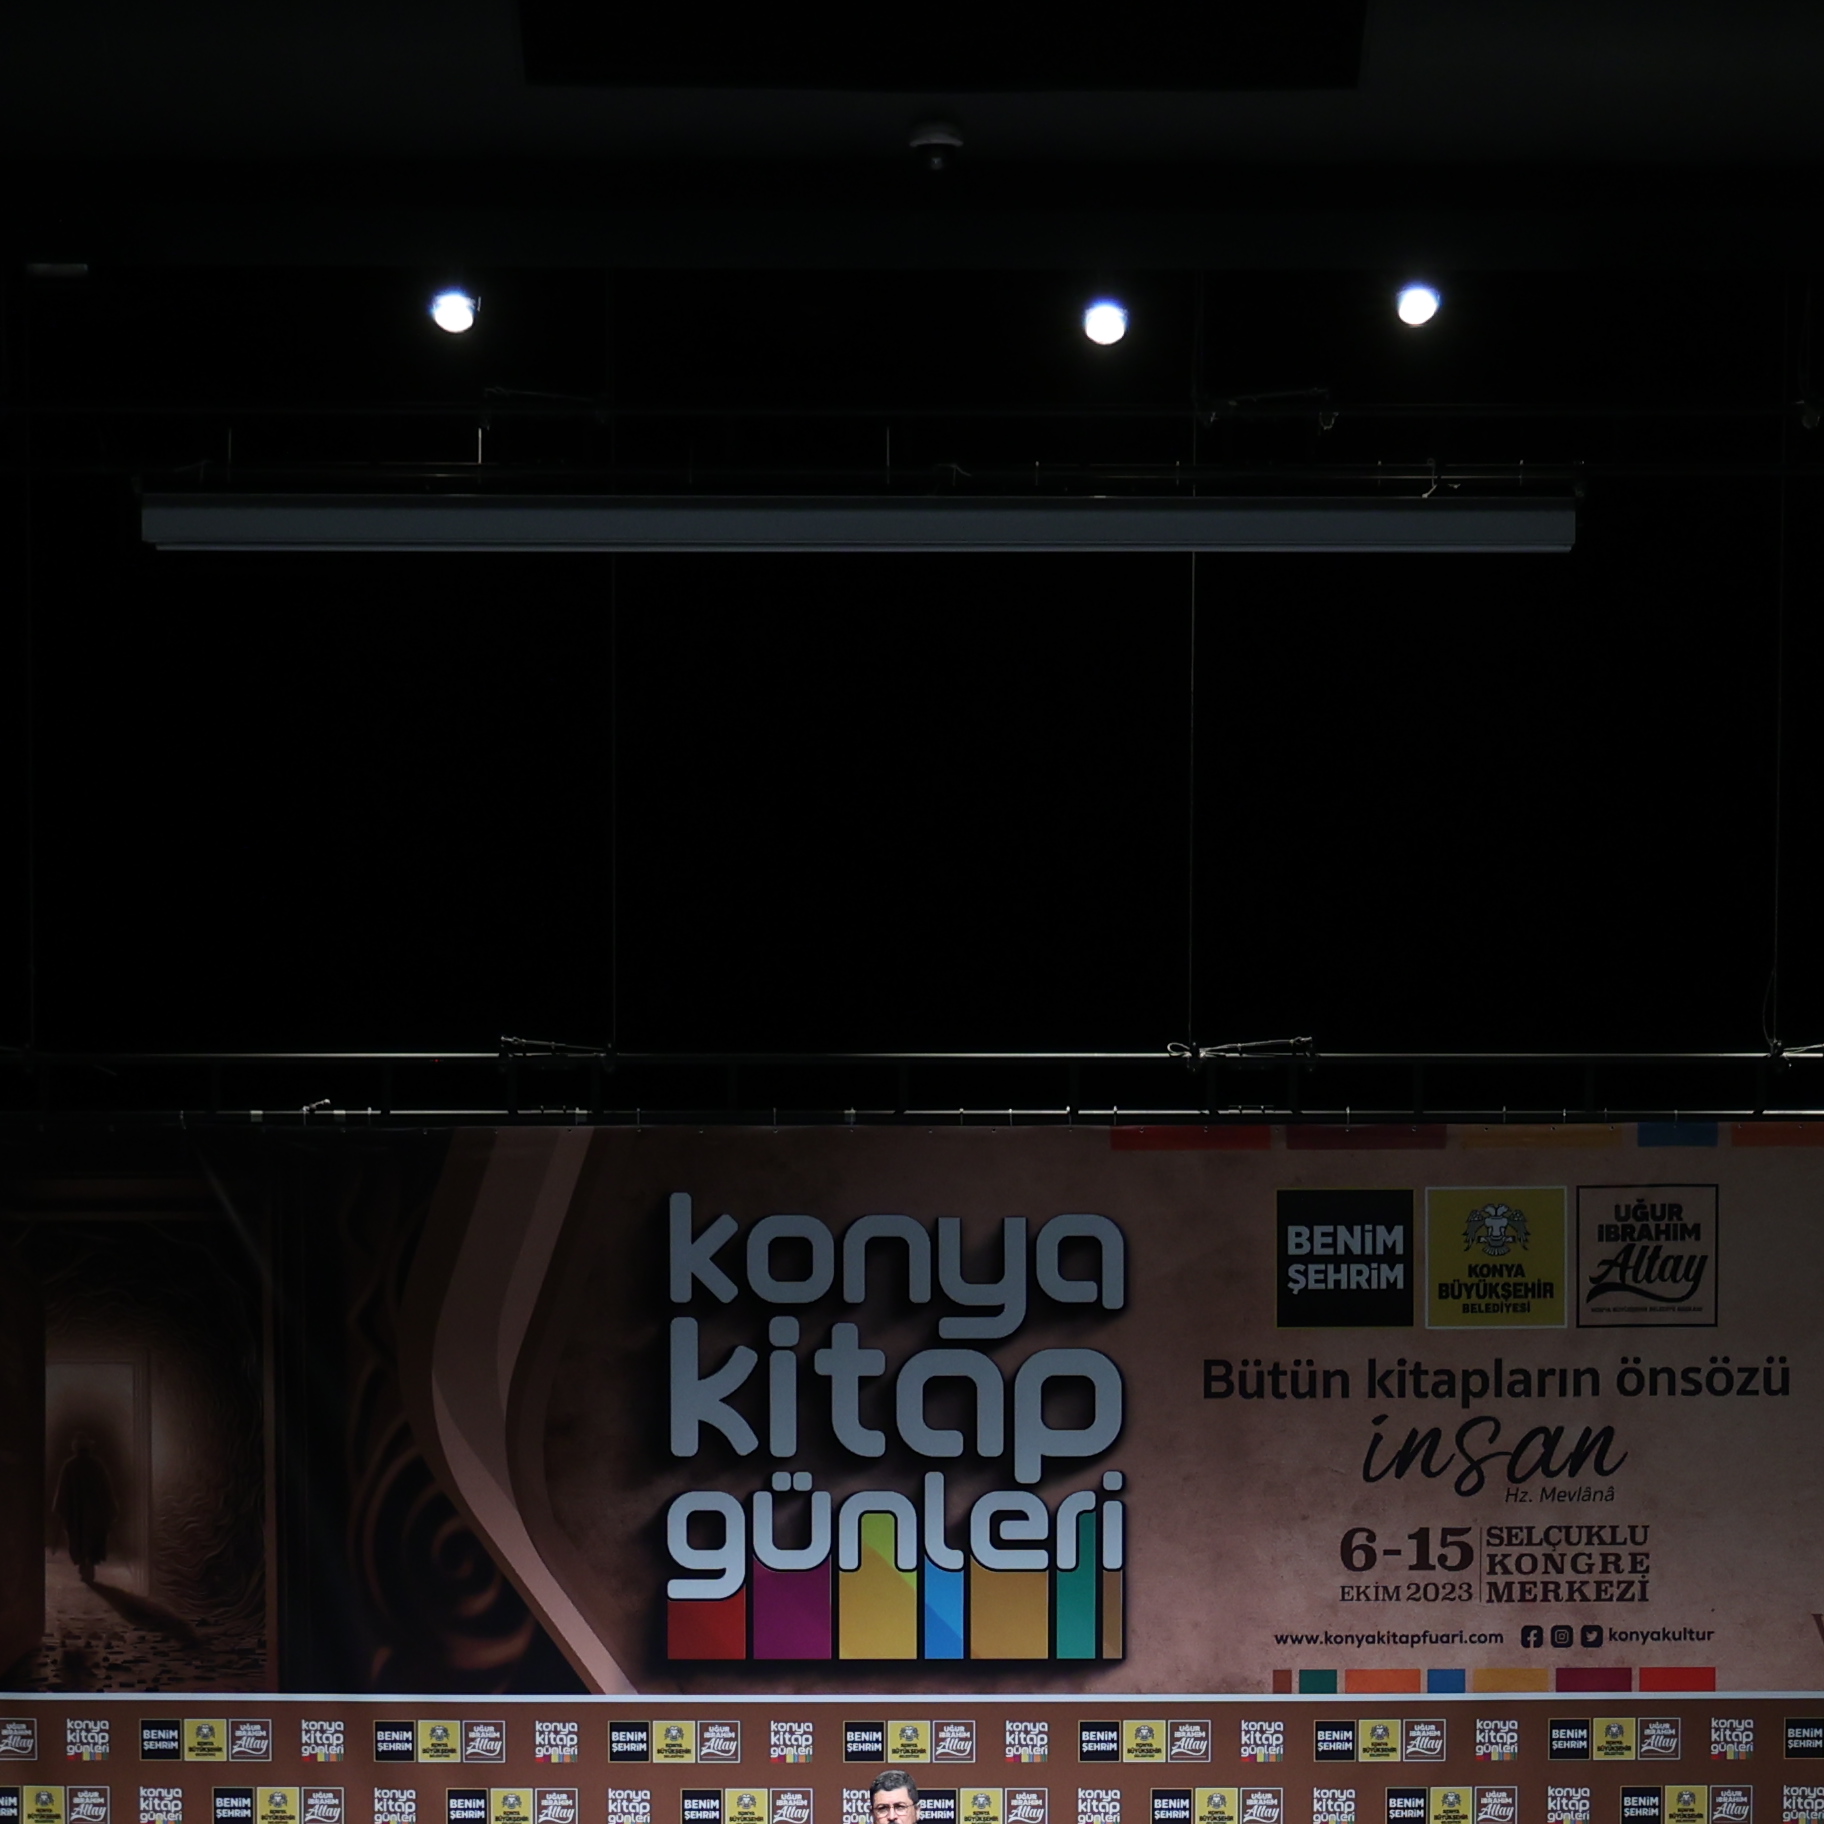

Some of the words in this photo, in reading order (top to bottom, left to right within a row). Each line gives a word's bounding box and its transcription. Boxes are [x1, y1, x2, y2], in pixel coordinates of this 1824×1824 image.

[1614, 1198, 1683, 1222] UĞUR
[669, 1192, 1124, 1339] konya
[1467, 1263, 1526, 1279] KONYA
[1586, 1242, 1709, 1304] Altay
[1438, 1277, 1555, 1302] BÜYÜKŞEHİR
[1461, 1300, 1531, 1314] BELEDİYESİ
[1202, 1358, 1350, 1400] Bütün
[1368, 1358, 1600, 1409] kitapların
[1616, 1355, 1791, 1398] önsözü
[670, 1316, 1123, 1484] kitap
[1362, 1414, 1628, 1498] insan
[1504, 1487, 1534, 1504] Hz.
[1539, 1485, 1616, 1504] Mevlânâ
[667, 1471, 1123, 1600] günleri
[1485, 1524, 1650, 1552] SELÇUKLU
[1340, 1526, 1474, 1572] 6-15
[1486, 1551, 1651, 1576] KONGRE
[1340, 1580, 1402, 1602] EKİM
[1406, 1582, 1473, 1602] 2023
[1486, 1573, 1650, 1604] MERKEZİ
[1275, 1629, 1504, 1647] www.konyakitapfuari.com
[1608, 1627, 1715, 1645] konyakultur
[66, 1718, 110, 1732] konya
[535, 1720, 579, 1734] konya
[1005, 1720, 1049, 1734] konya
[1475, 1718, 1519, 1732] konya
[66, 1731, 110, 1745] kitap
[535, 1733, 579, 1747] kitap
[1005, 1733, 1049, 1747] kitap
[1475, 1731, 1519, 1745] kitap
[66, 1744, 110, 1756] günleri
[535, 1746, 579, 1758] günleri
[1005, 1746, 1049, 1758] günleri
[1475, 1744, 1519, 1756] günleri
[373, 1787, 417, 1801] konya
[1077, 1787, 1121, 1801] konya
[1547, 1785, 1591, 1799] konya
[373, 1800, 417, 1814] kitap
[1077, 1800, 1121, 1814] kitap
[1547, 1798, 1591, 1812] kitap
[373, 1813, 417, 1824] günleri
[1077, 1813, 1121, 1824] günleri
[1547, 1811, 1591, 1823] günleri
